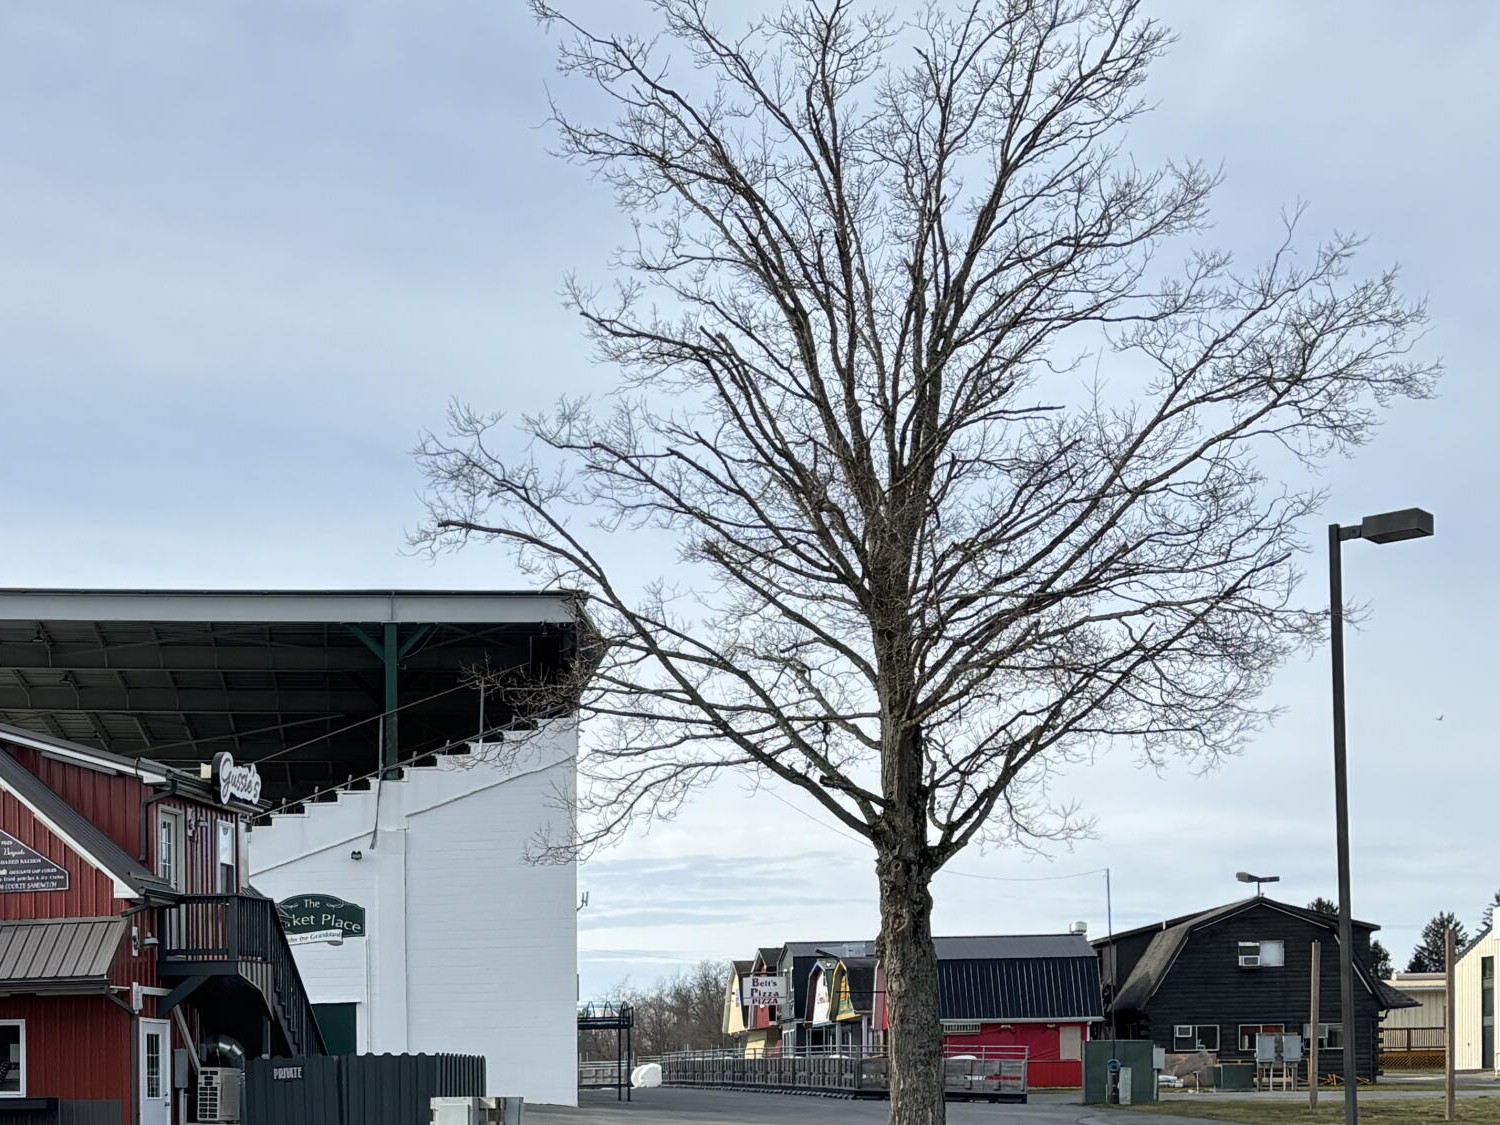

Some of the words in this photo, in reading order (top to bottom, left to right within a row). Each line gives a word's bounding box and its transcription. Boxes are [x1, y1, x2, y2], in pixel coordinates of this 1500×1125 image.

[304, 899, 321, 909] The
[321, 913, 361, 933] Place
[750, 988, 780, 998] Pizza
[273, 1066, 303, 1080] PRIVATE
